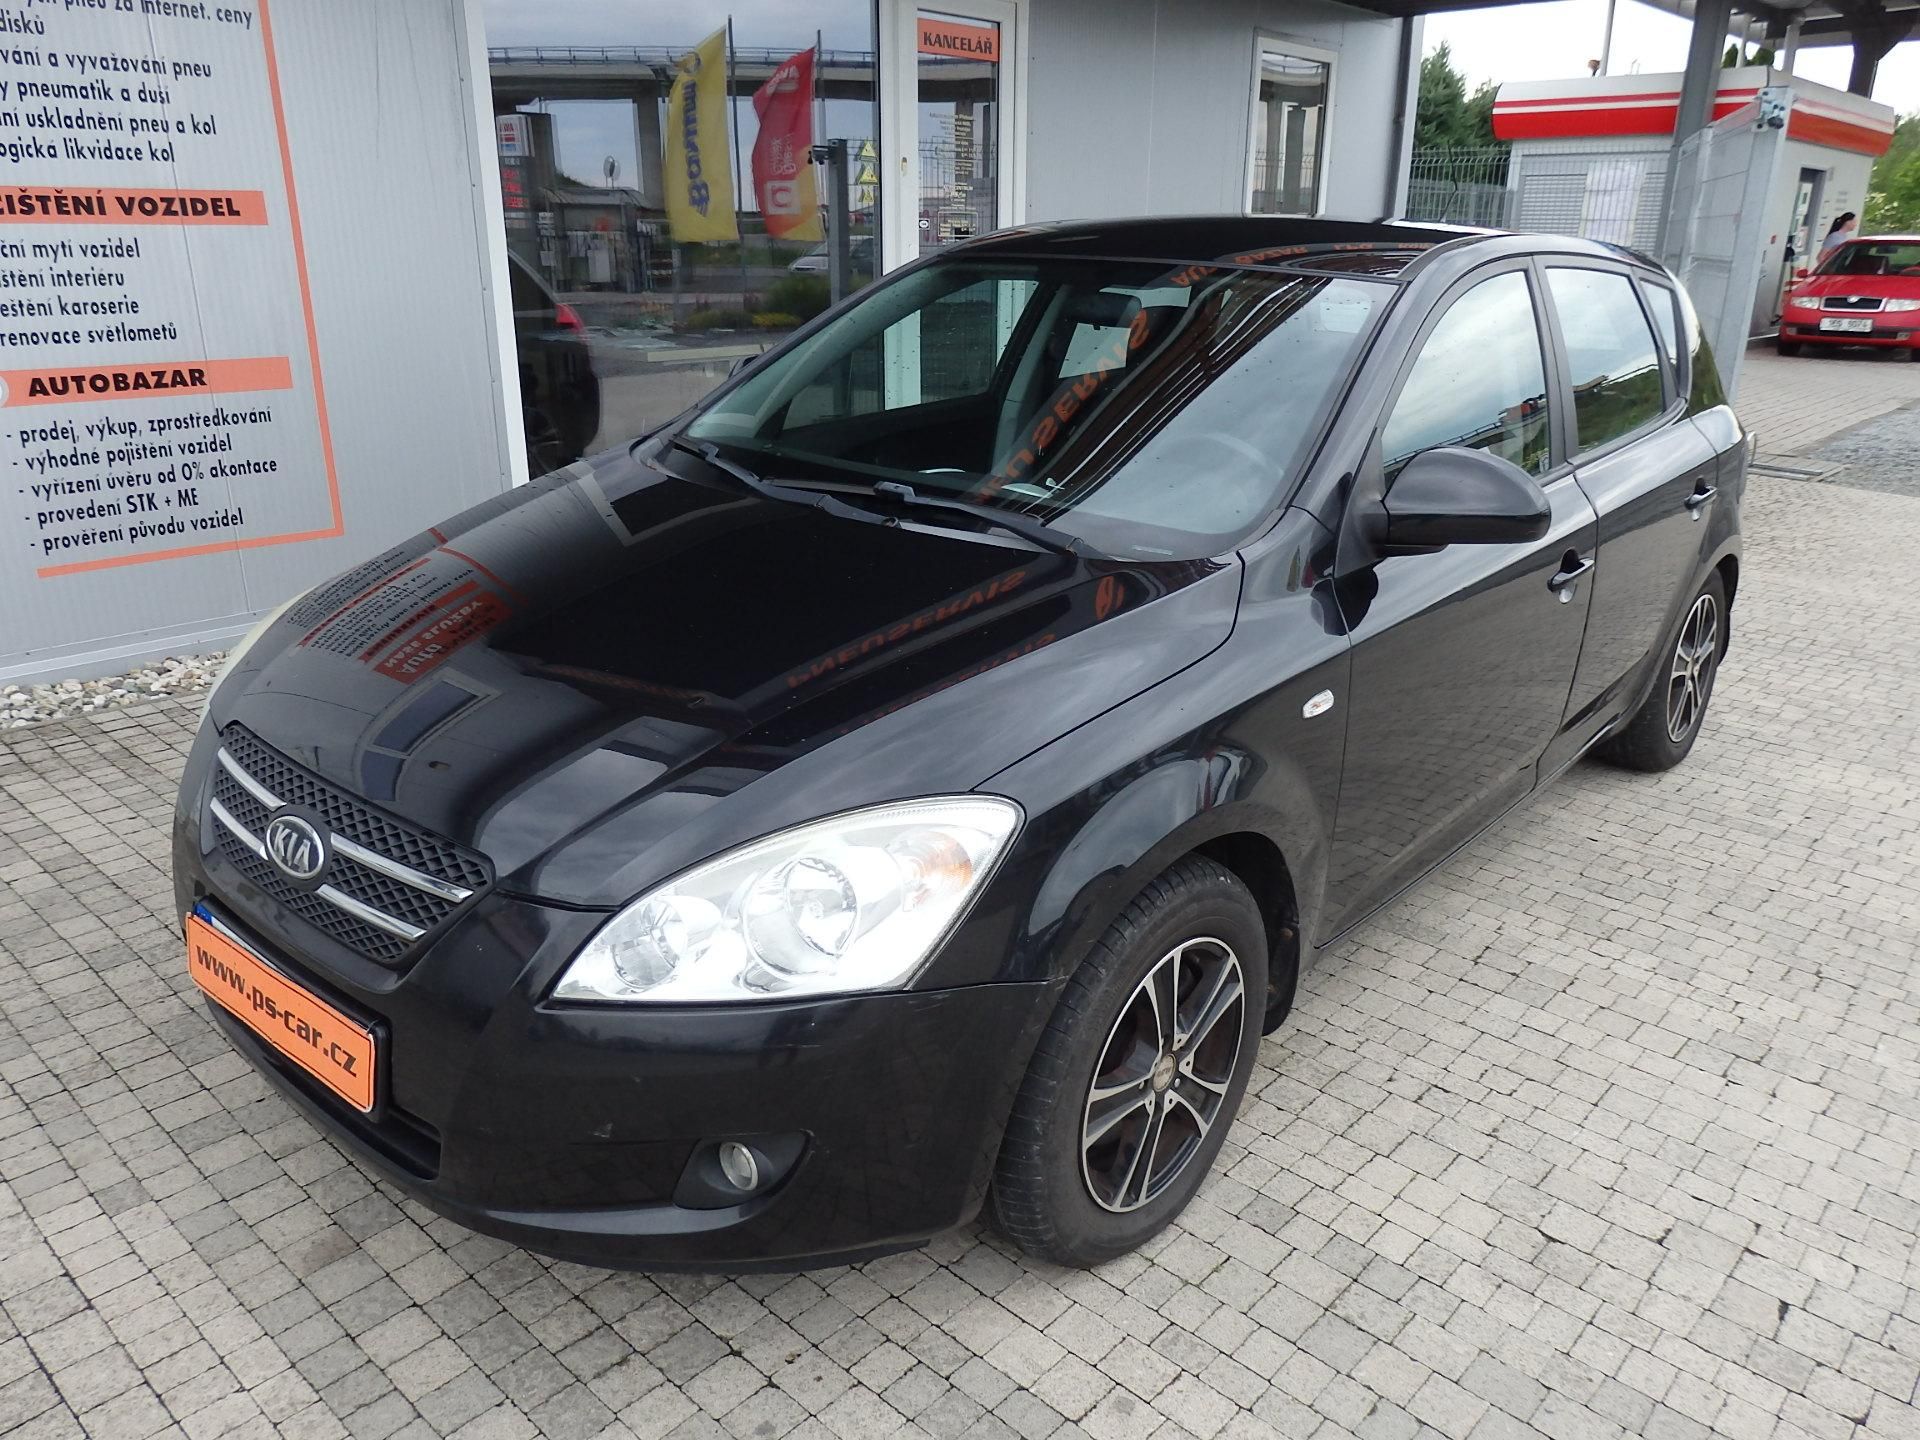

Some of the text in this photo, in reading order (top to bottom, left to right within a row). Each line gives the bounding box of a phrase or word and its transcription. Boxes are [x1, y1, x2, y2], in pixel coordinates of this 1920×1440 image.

[216, 8, 252, 30] ceny
[924, 32, 993, 54] KANCELÁŘ
[48, 51, 59, 67] a
[66, 52, 167, 75] vyvažování
[173, 60, 212, 80] pneu
[17, 79, 115, 102] pneumatik
[120, 88, 131, 102] a
[138, 82, 170, 104] duší
[26, 105, 123, 131] uskladnění
[130, 118, 170, 137] pneu
[176, 120, 186, 133] a
[191, 113, 217, 135] kol
[63, 137, 143, 161] likvidace
[148, 140, 175, 163] kol
[0, 187, 241, 217] IŠTĚNÍ VOZIDEL
[33, 239, 73, 263] mytí
[79, 237, 140, 258] vozidel
[50, 266, 124, 287] interiéru
[58, 295, 139, 316] karoserie
[0, 321, 177, 347] renovace světlometů
[29, 368, 207, 397] AUTOBAZAR
[20, 420, 80, 447] prodej,
[86, 416, 142, 442] výkup,
[148, 407, 273, 435] zprostředkování
[25, 448, 100, 475] výhodné
[106, 442, 173, 467] pojištění
[178, 433, 232, 456] vozidel
[31, 477, 101, 501] vyřízení
[106, 470, 151, 490] úvěru
[158, 464, 176, 484] od
[182, 461, 204, 481] 0%
[210, 458, 277, 478] akontace
[37, 500, 121, 529] provedení
[127, 493, 158, 514] STK
[178, 488, 199, 508] ME
[43, 525, 123, 556] prověření
[129, 515, 185, 541] původu
[191, 507, 244, 531] vozidel
[272, 824, 309, 873] KIA
[196, 944, 358, 1077] www.ps-car.cz
